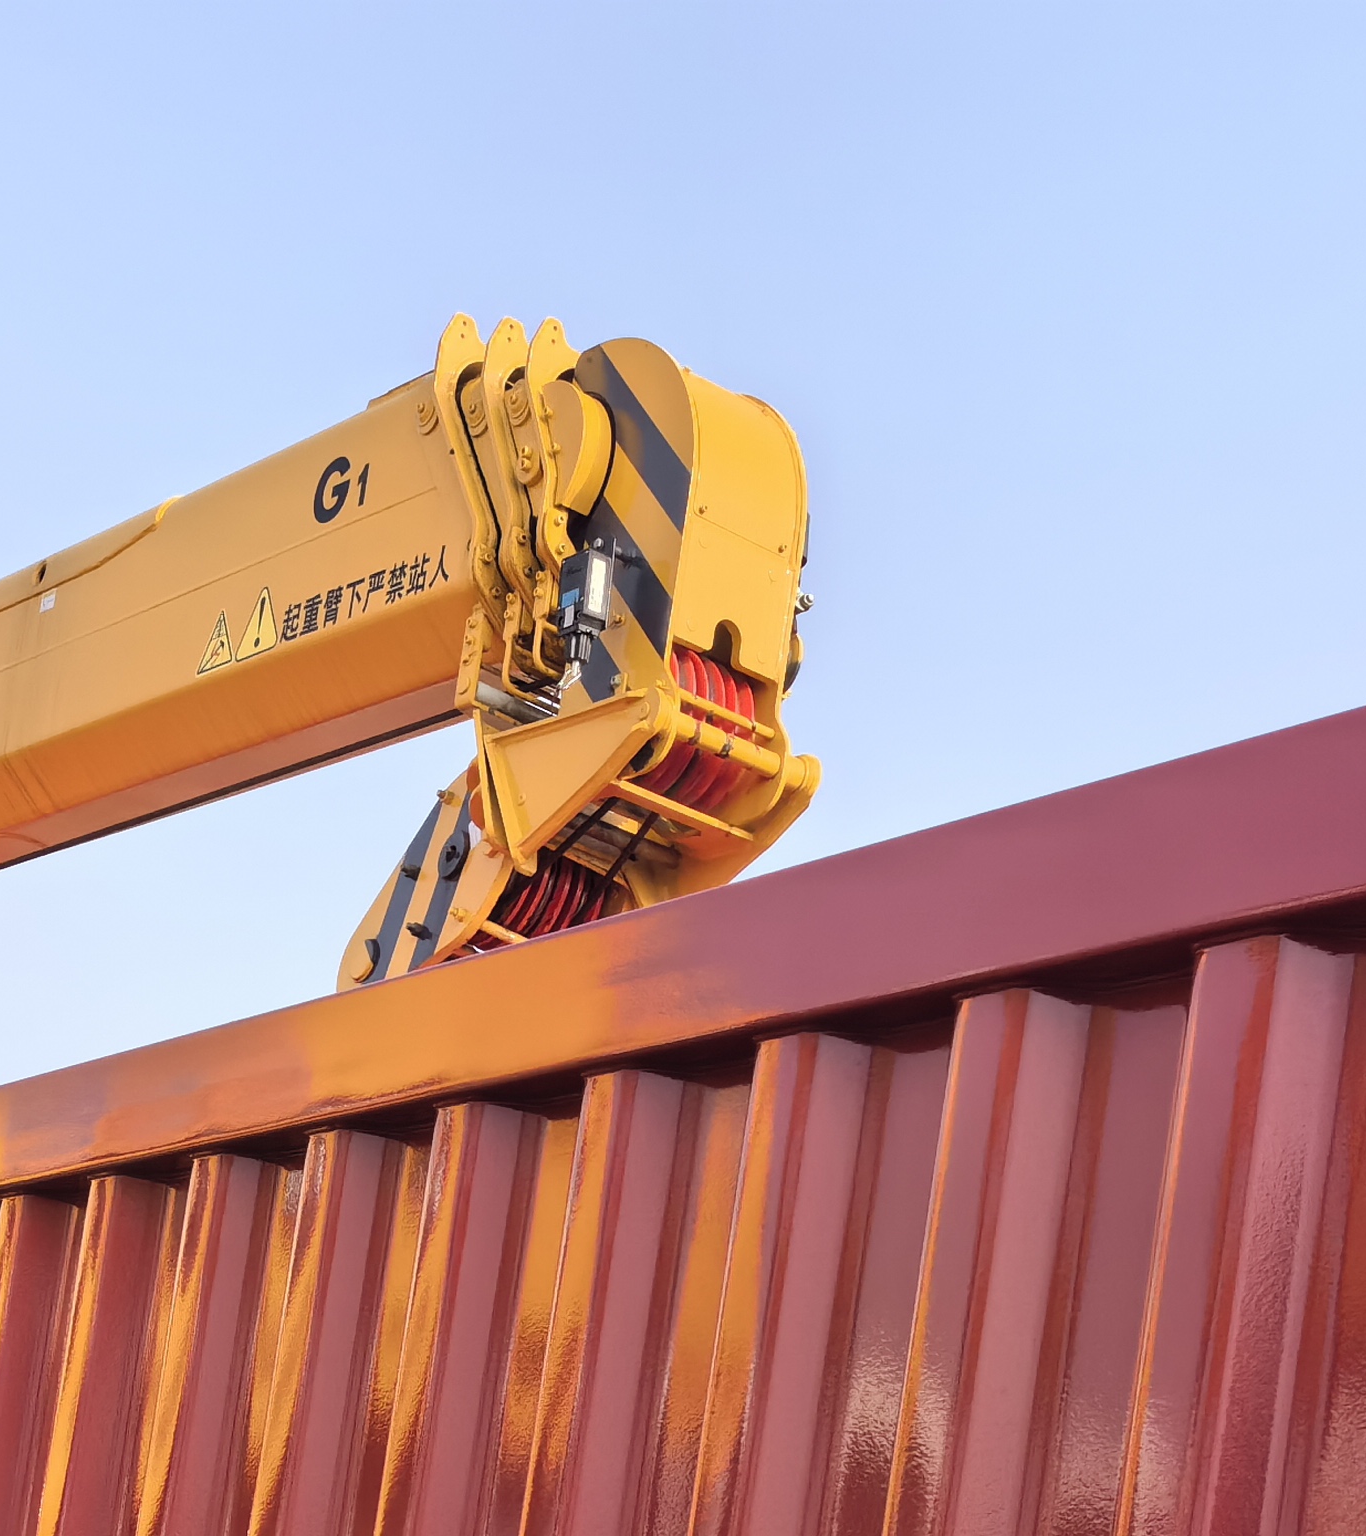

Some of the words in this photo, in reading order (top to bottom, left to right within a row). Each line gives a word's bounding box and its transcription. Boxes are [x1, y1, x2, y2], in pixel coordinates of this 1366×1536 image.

[313, 456, 370, 524] G1
[279, 545, 449, 643] 起重臂下严禁站人
